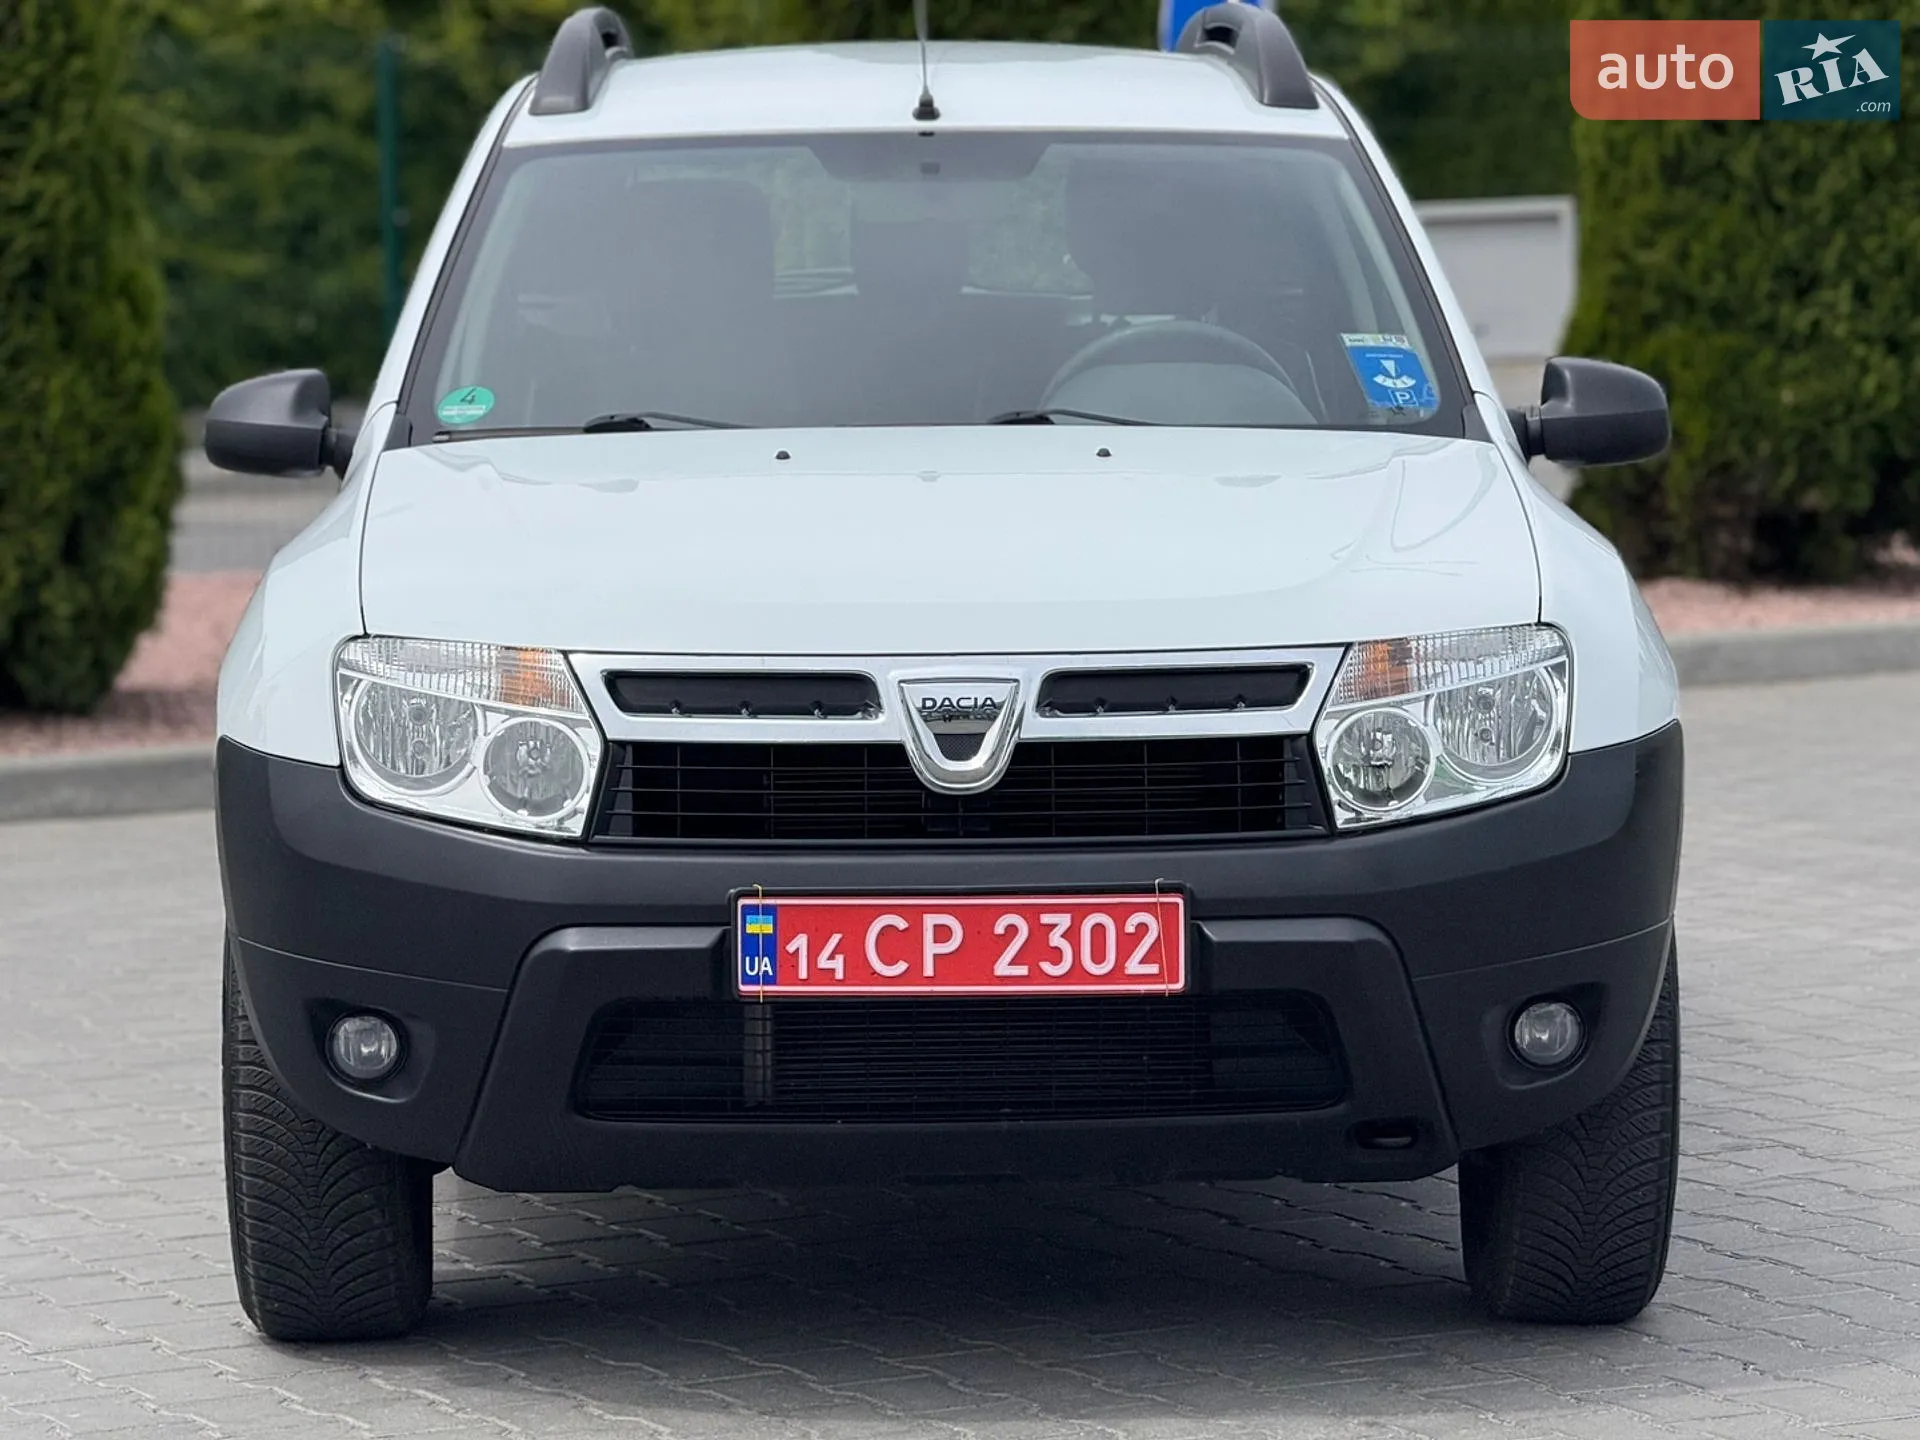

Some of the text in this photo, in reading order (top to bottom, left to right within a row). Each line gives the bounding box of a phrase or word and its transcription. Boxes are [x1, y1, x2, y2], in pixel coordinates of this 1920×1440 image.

[460, 387, 477, 405] 4
[1394, 391, 1411, 405] P
[921, 697, 997, 710] DACIA
[785, 912, 1160, 980] 14 CP 2302
[745, 956, 773, 976] UA
